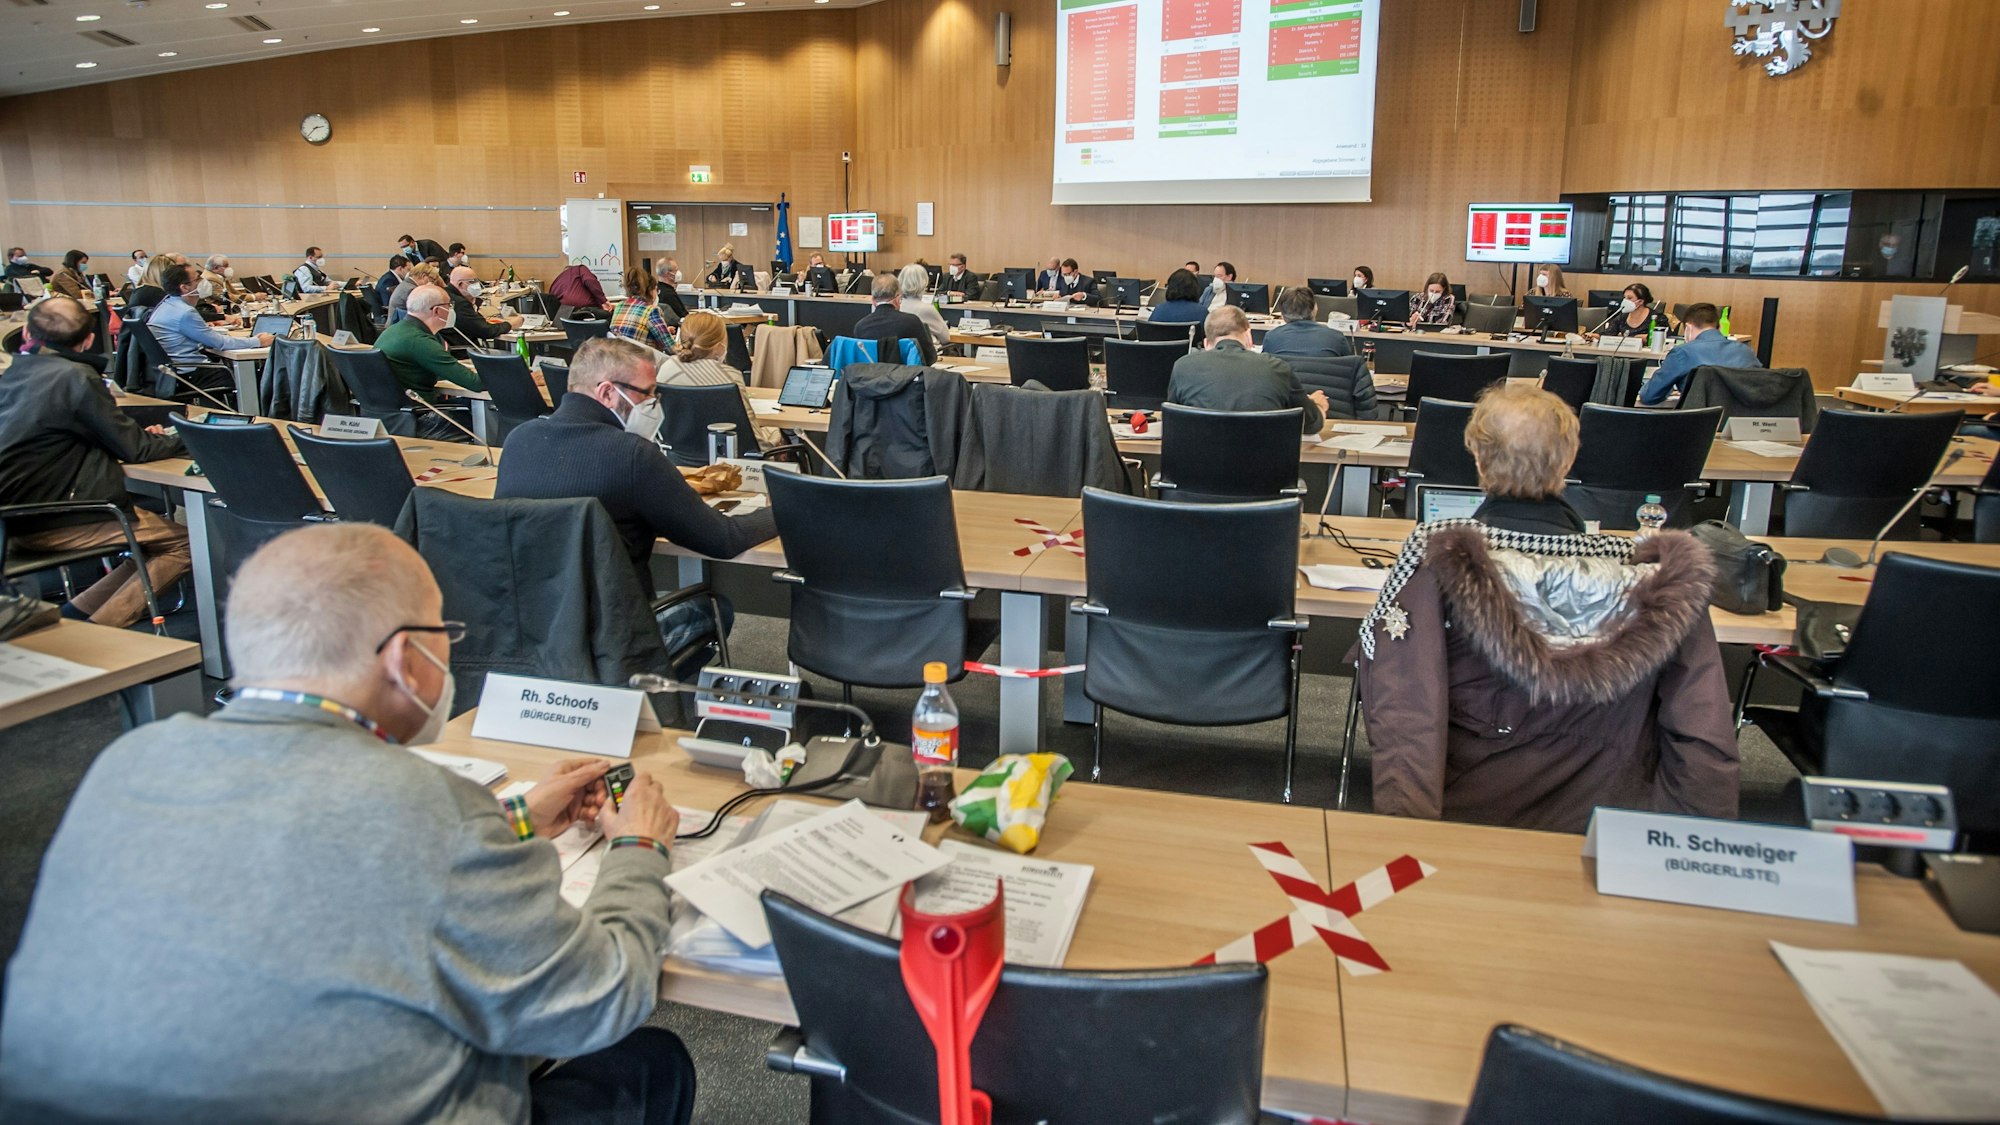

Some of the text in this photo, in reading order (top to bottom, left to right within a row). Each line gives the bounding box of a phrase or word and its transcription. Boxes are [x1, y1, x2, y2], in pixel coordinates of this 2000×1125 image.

[521, 689, 599, 711] Rh. Schoofs
[520, 708, 591, 728] (BÜRGERLISTE)
[1647, 829, 1798, 864] Rh. Schweiger
[1665, 857, 1781, 886] (BÜRGERLISTE)
